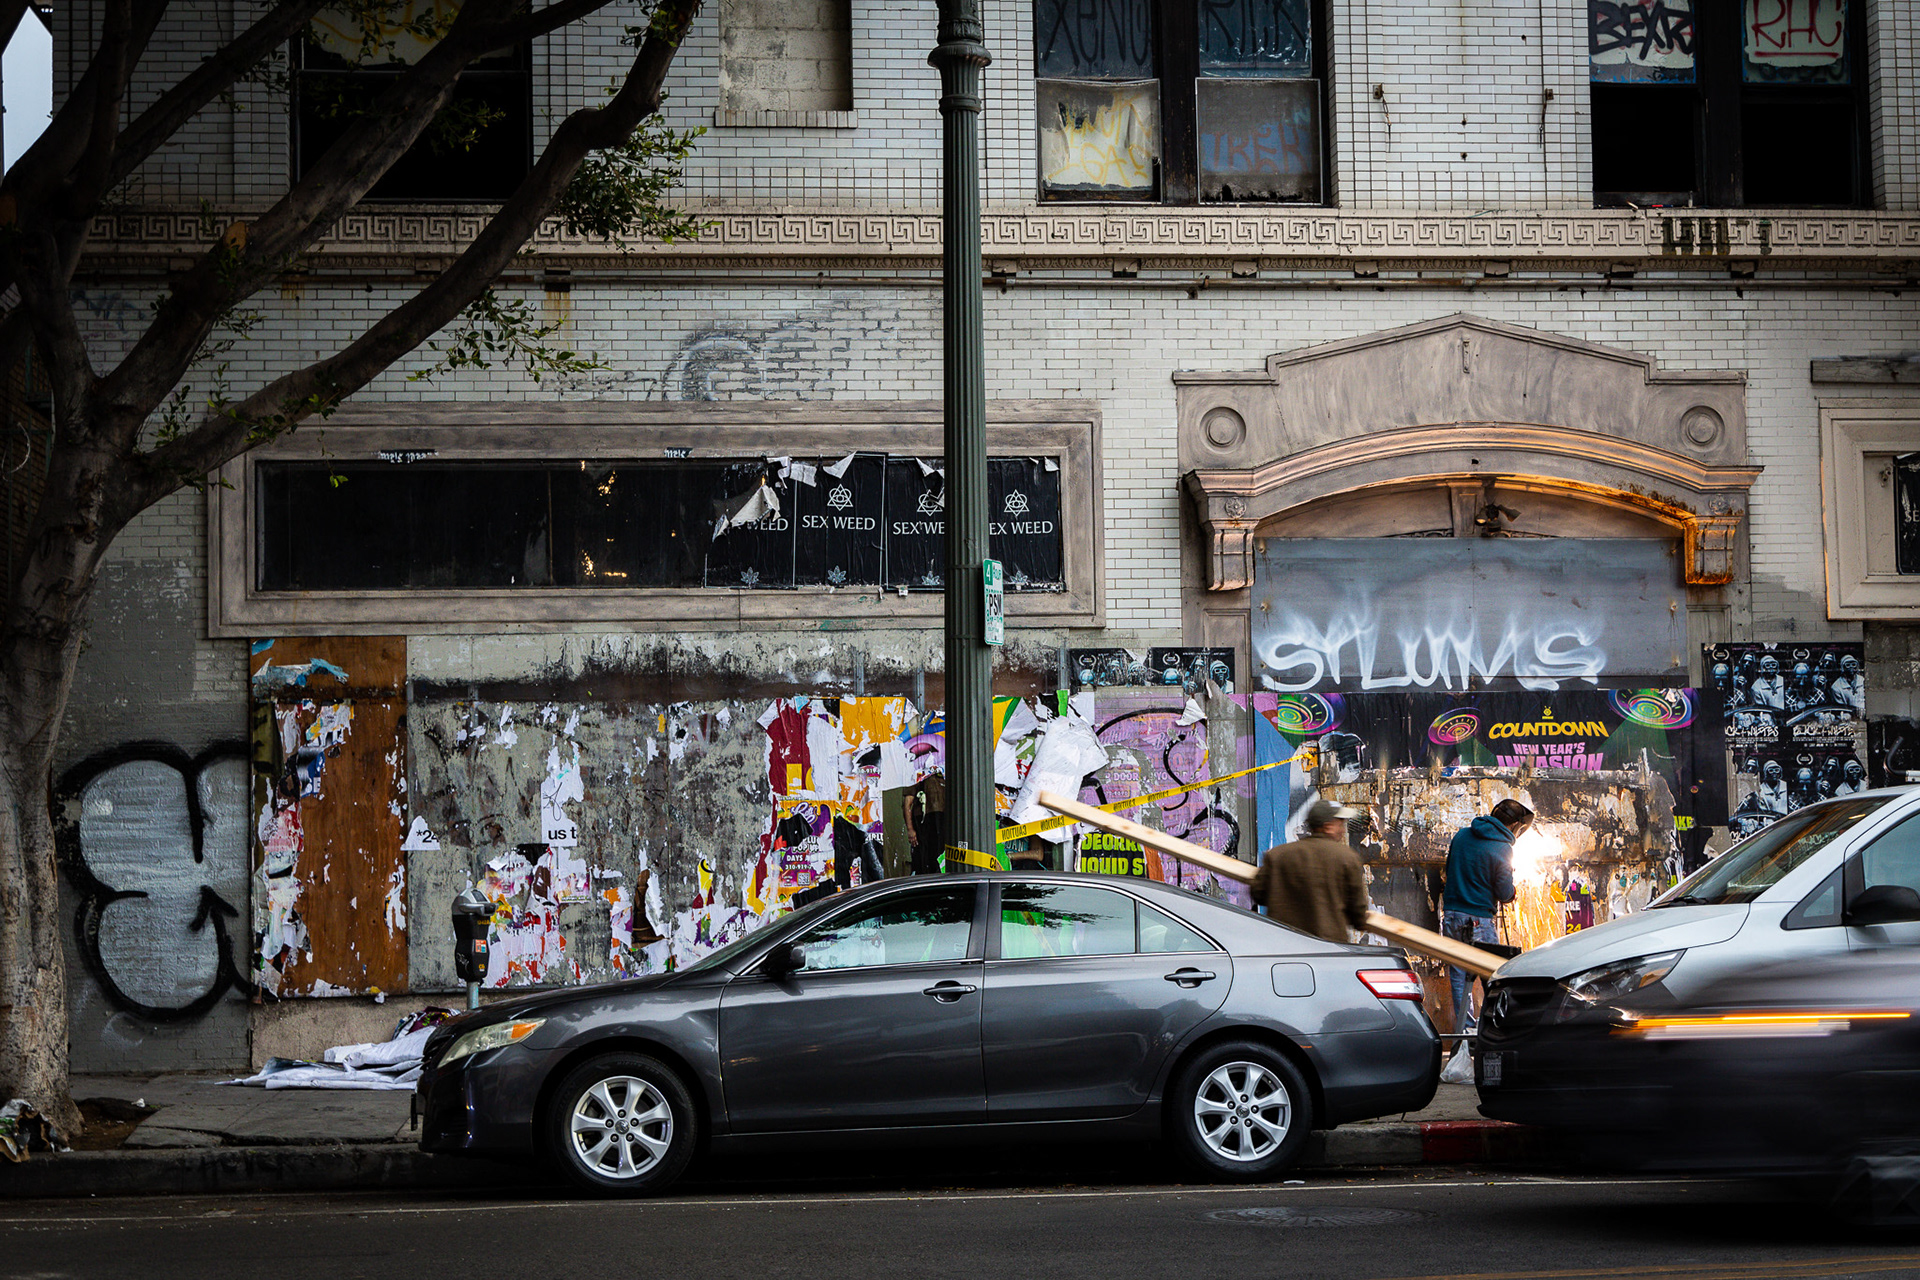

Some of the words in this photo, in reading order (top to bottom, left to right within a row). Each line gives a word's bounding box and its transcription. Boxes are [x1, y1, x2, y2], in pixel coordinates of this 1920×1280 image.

[801, 514, 829, 528] SEX
[833, 516, 876, 530] WEED
[1904, 510, 1920, 522] SE
[754, 518, 789, 531] EED
[892, 522, 920, 535] SEX
[924, 522, 945, 535] WE
[989, 522, 1006, 535] EX
[1011, 521, 1054, 535] WEED
[986, 564, 991, 582] 4
[1488, 721, 1610, 740] COUNTDOWN
[1512, 743, 1540, 755] NEW
[1542, 742, 1586, 755] YEAR'S
[1114, 772, 1140, 781] DOOR
[548, 829, 567, 840] us
[786, 854, 803, 862] DAYS
[946, 847, 967, 862] TION
[1081, 857, 1129, 875] IQUID
